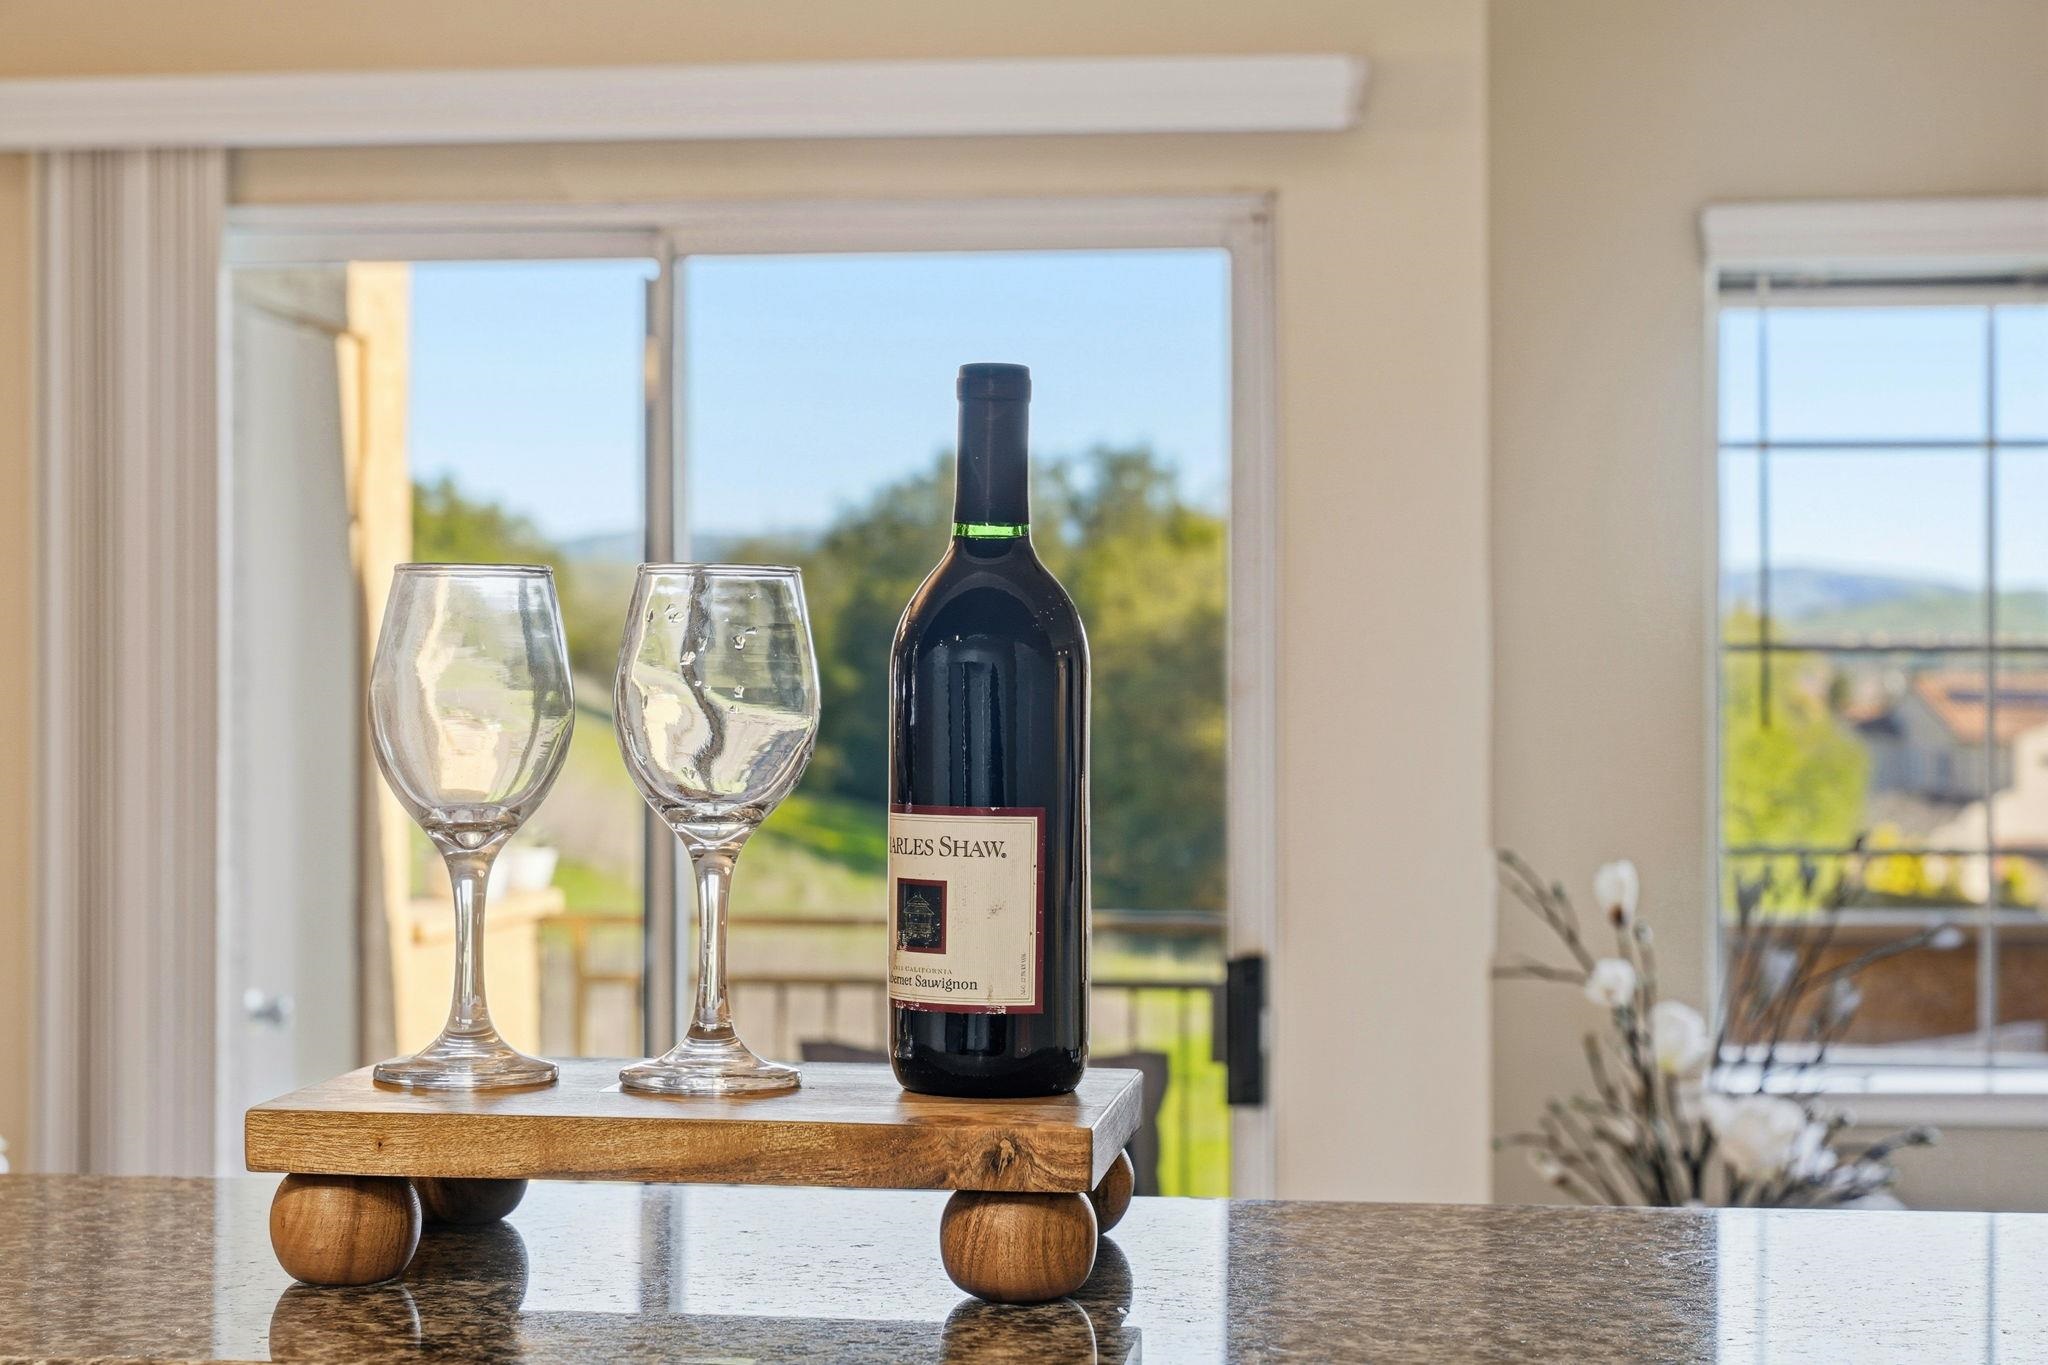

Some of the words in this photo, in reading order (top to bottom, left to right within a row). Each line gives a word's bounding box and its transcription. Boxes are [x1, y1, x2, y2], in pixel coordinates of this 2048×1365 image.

[889, 836, 934, 857] ARLES
[903, 965, 953, 975] CALIFORNIA
[914, 974, 978, 992] Sauvignon
